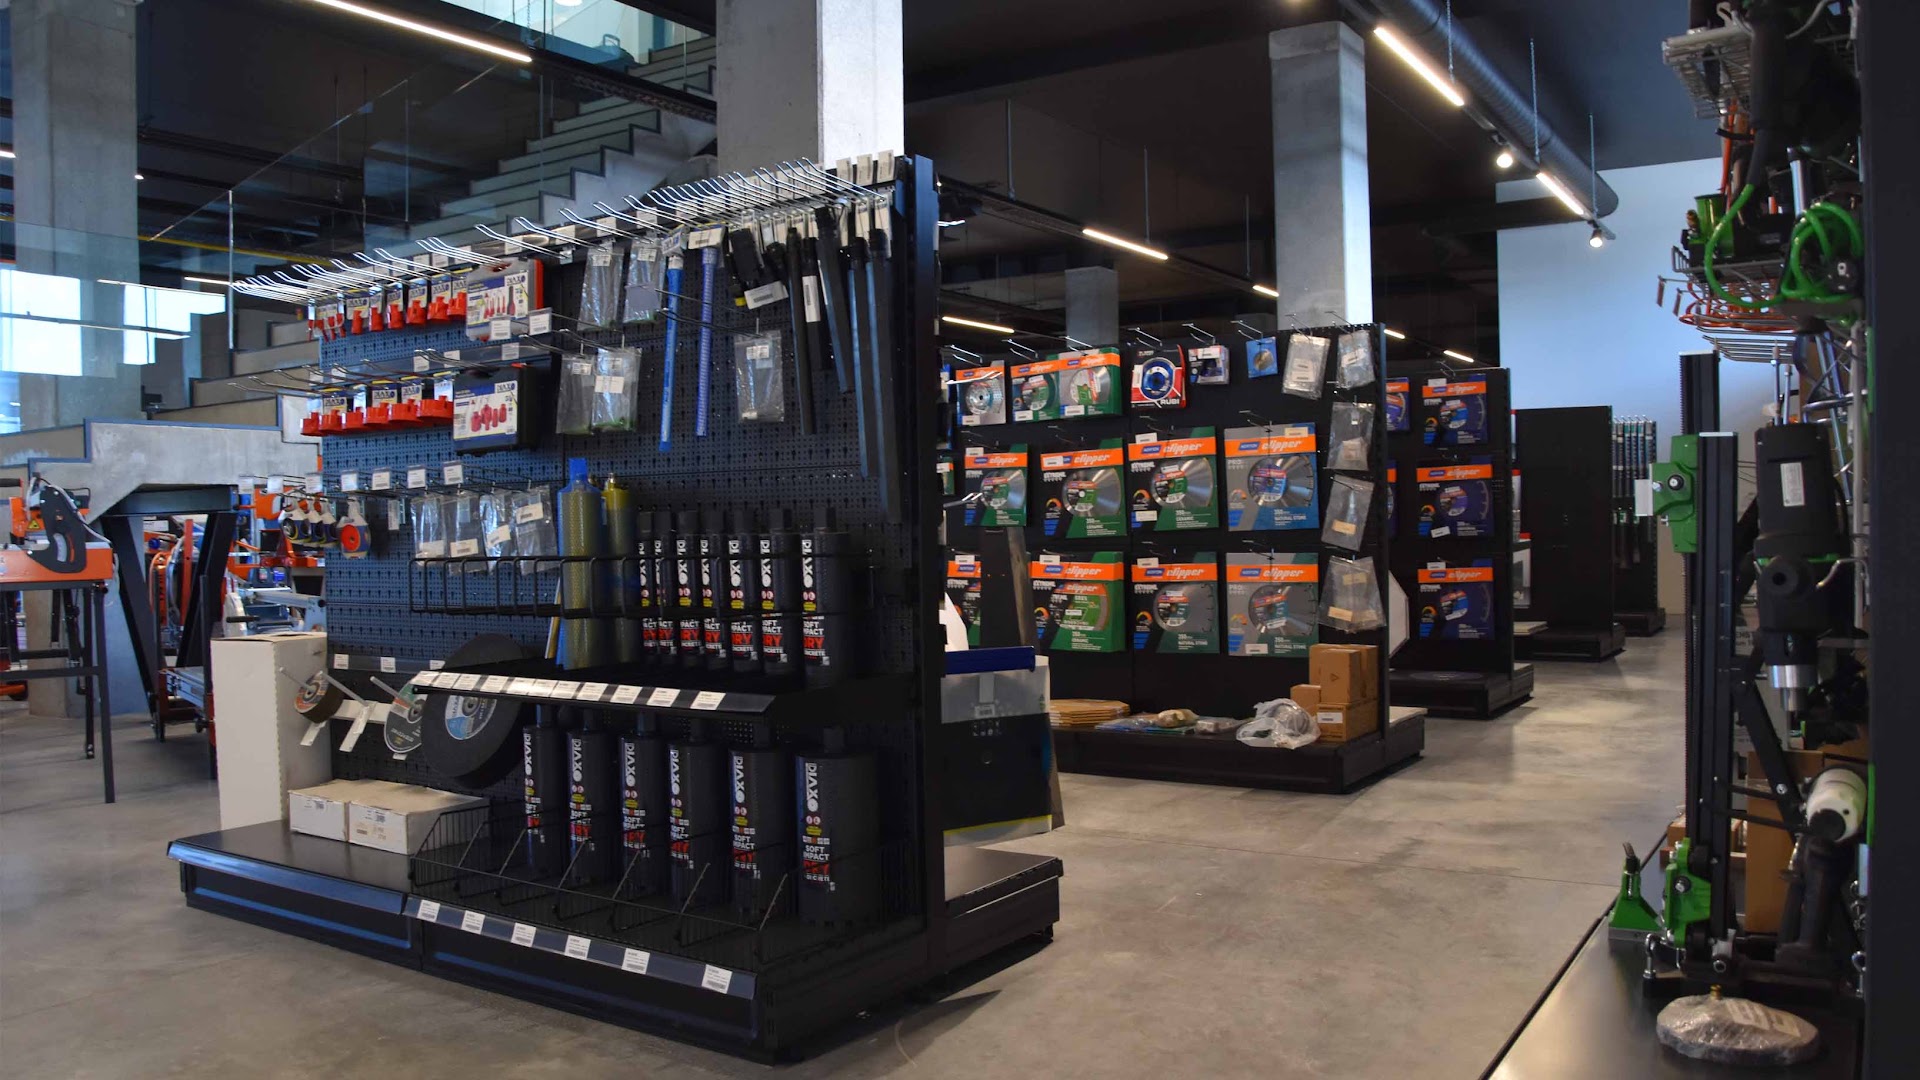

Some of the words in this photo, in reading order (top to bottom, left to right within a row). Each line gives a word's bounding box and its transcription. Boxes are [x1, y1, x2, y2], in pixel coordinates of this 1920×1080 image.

[1163, 443, 1202, 455] clipper
[1261, 440, 1302, 452] clipper
[989, 456, 1018, 466] clipper
[1073, 454, 1110, 466] clipper
[1065, 565, 1102, 578] clipper
[1166, 567, 1204, 579] clipper
[1262, 567, 1303, 580] clipper
[1067, 583, 1098, 594] clipper
[571, 738, 583, 782] DIAXO
[624, 742, 636, 787] DIAXO
[669, 749, 680, 795] DIAXO
[733, 755, 746, 804] DIAXO
[805, 762, 819, 813] DIAXO
[733, 834, 751, 843] SOFT
[805, 845, 825, 853] SOFT
[803, 851, 830, 861] IMPACT
